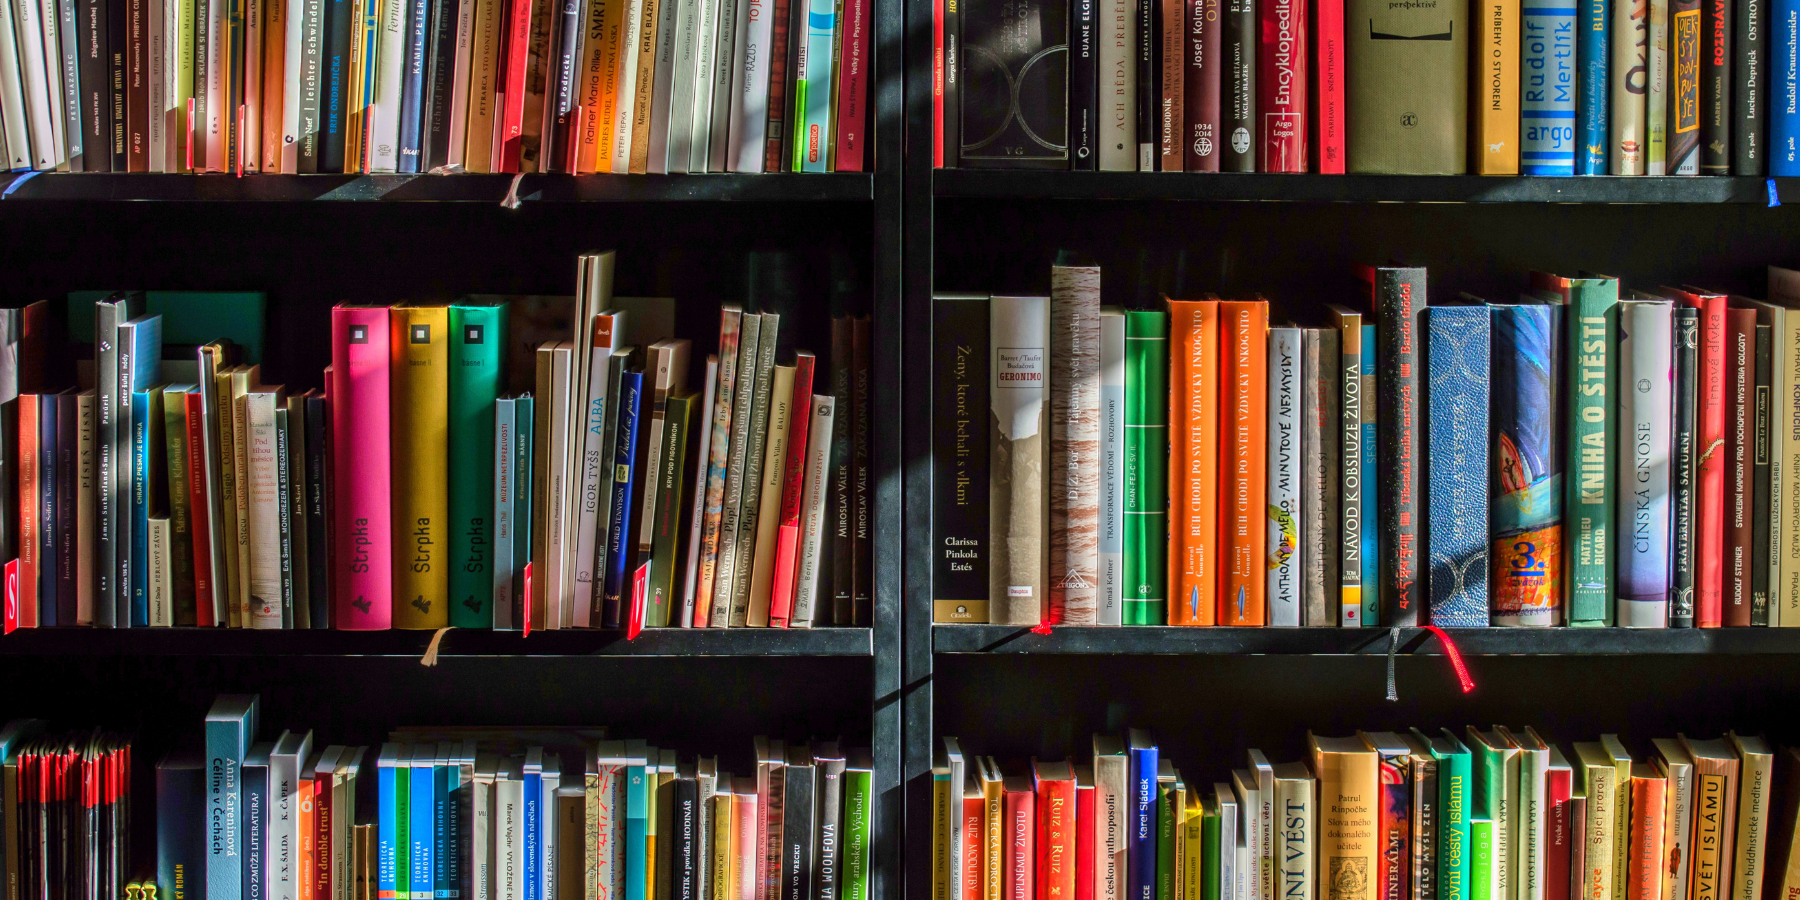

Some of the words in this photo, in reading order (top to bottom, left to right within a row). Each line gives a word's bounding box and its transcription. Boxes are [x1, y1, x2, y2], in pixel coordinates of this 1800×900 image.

[1193, 37, 1203, 68] Josef
[1526, 21, 1544, 102] Rudolf
[1555, 21, 1571, 102] Mertlík
[1788, 10, 1797, 79] Krautschneider
[67, 54, 75, 96] MAZANEC
[330, 55, 340, 111] ONDREJIČKA
[1115, 55, 1125, 96] BĚDA,
[1748, 50, 1757, 88] Deprijck
[1747, 90, 1755, 119] Lucien
[1787, 82, 1796, 114] Rudolf
[329, 113, 337, 134] ERIK
[619, 111, 627, 133] REPKA
[1116, 103, 1124, 130] ACH
[1273, 130, 1294, 138] Logos
[1527, 126, 1573, 149] argo
[1193, 310, 1202, 367] INKOGNITO
[1240, 310, 1250, 367] INKOGNITO
[954, 345, 971, 379] Ženy,
[1578, 316, 1606, 397] ŠTĚSTÍ
[958, 385, 969, 416] ktoré
[1192, 372, 1201, 421] VŽDYCKY
[1239, 372, 1249, 421] VŽDYCKY
[1344, 364, 1358, 419] ŽIVOTA
[1737, 366, 1745, 404] MYSTERIA
[81, 404, 89, 440] PÍSNÍ
[590, 397, 604, 435] ALBA
[1583, 407, 1605, 423] O
[957, 420, 969, 458] behali
[1191, 425, 1201, 456] SVĚTĚ
[1239, 425, 1249, 456] SVĚTĚ
[1346, 424, 1358, 488] OBSLUZE
[1637, 421, 1651, 484] GNOSE
[82, 450, 90, 488] PÍSEŇ
[587, 450, 599, 479] TYŠŠ
[1192, 460, 1201, 474] PO
[1239, 460, 1248, 474] PO
[1581, 434, 1605, 505] KNIHA
[1680, 431, 1689, 485] SATURNI
[586, 483, 597, 514] IGOR
[615, 488, 624, 521] TENNYSON
[957, 470, 969, 505] vlkmi
[1192, 478, 1201, 512] CHODÍ
[1239, 478, 1248, 512] CHODÍ
[1346, 491, 1358, 501] K
[613, 525, 621, 552] ALFRED
[707, 521, 715, 555] VIDMAR
[1192, 516, 1201, 535] BŮH
[1239, 516, 1248, 535] BŮH
[1345, 506, 1358, 560] NÁVOD
[1633, 489, 1650, 554] ČÍNSKÁ
[1678, 489, 1688, 572] FRATERNITAS
[351, 517, 372, 573] Štrpka
[410, 517, 434, 573] Štrpka
[463, 517, 487, 573] Štrpka
[945, 537, 978, 546] Clarissa
[946, 549, 978, 558] Pinkola
[1511, 541, 1545, 569] 3.
[1581, 517, 1591, 565] MATTHIEU
[1595, 529, 1604, 565] RICARD
[704, 559, 712, 580] MAJA
[951, 563, 972, 571] Estés
[1186, 546, 1194, 574] Laurent
[1242, 543, 1250, 577] Gounelle
[1512, 577, 1545, 586] zväzok
[213, 758, 222, 796] Céline
[226, 758, 235, 786] Anna
[1677, 776, 1685, 802] Robin
[280, 780, 289, 806] ČAPEK
[1139, 778, 1149, 810] Sládek
[1451, 775, 1462, 825] islámu
[1596, 776, 1604, 811] prorok
[1753, 770, 1762, 813] meditace
[227, 790, 237, 857] Kareninová
[282, 810, 288, 821] K.
[684, 800, 692, 839] HODINÁŘ
[853, 792, 863, 831] Východu
[1139, 812, 1148, 839] Karel
[1328, 818, 1349, 827] Slova
[1350, 818, 1371, 827] mého
[1674, 804, 1684, 835] Sharma
[1703, 781, 1718, 851] ISLÁMU
[214, 807, 225, 855] Čechách
[1016, 811, 1026, 847] ŽIVOTU
[1287, 799, 1305, 862] VÉST
[1328, 830, 1371, 839] dokonalého
[1336, 841, 1362, 850] učitele
[1451, 828, 1463, 863] cesty
[1594, 815, 1603, 844] Spící
[822, 823, 834, 883] WOOLFOVÁ
[852, 834, 860, 879] arabského
[1748, 816, 1759, 877] buddhistické
[282, 861, 288, 873] X.
[282, 874, 288, 882] F.
[794, 876, 800, 886] VO
[1421, 868, 1429, 896] TĚLO
[436, 890, 444, 898] 32
